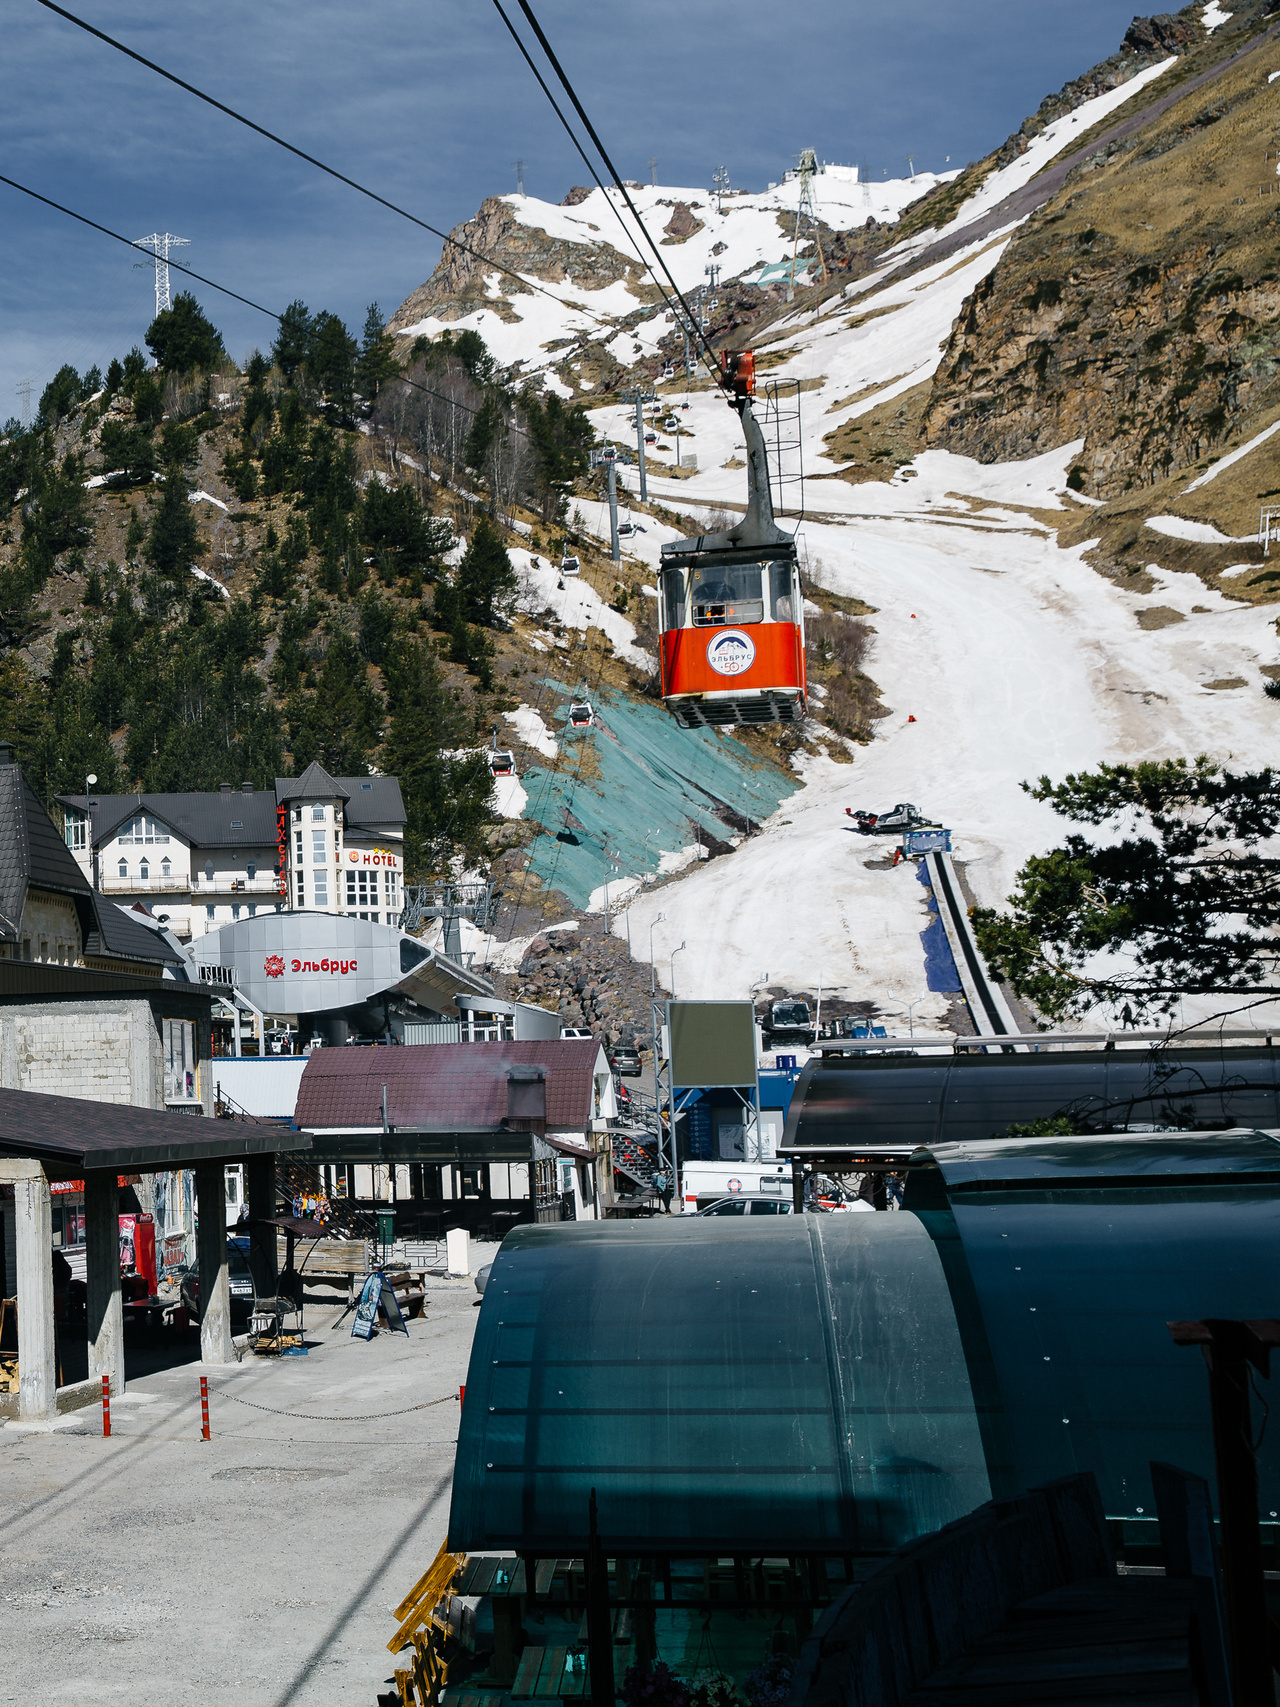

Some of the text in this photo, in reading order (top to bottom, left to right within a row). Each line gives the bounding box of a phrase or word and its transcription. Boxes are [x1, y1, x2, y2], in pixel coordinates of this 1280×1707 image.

[694, 571, 701, 580] 5
[711, 653, 752, 663] ЭЛЬБРУС
[724, 662, 740, 673] 50
[363, 854, 397, 868] HOTEL
[291, 958, 358, 975] Эльбрус
